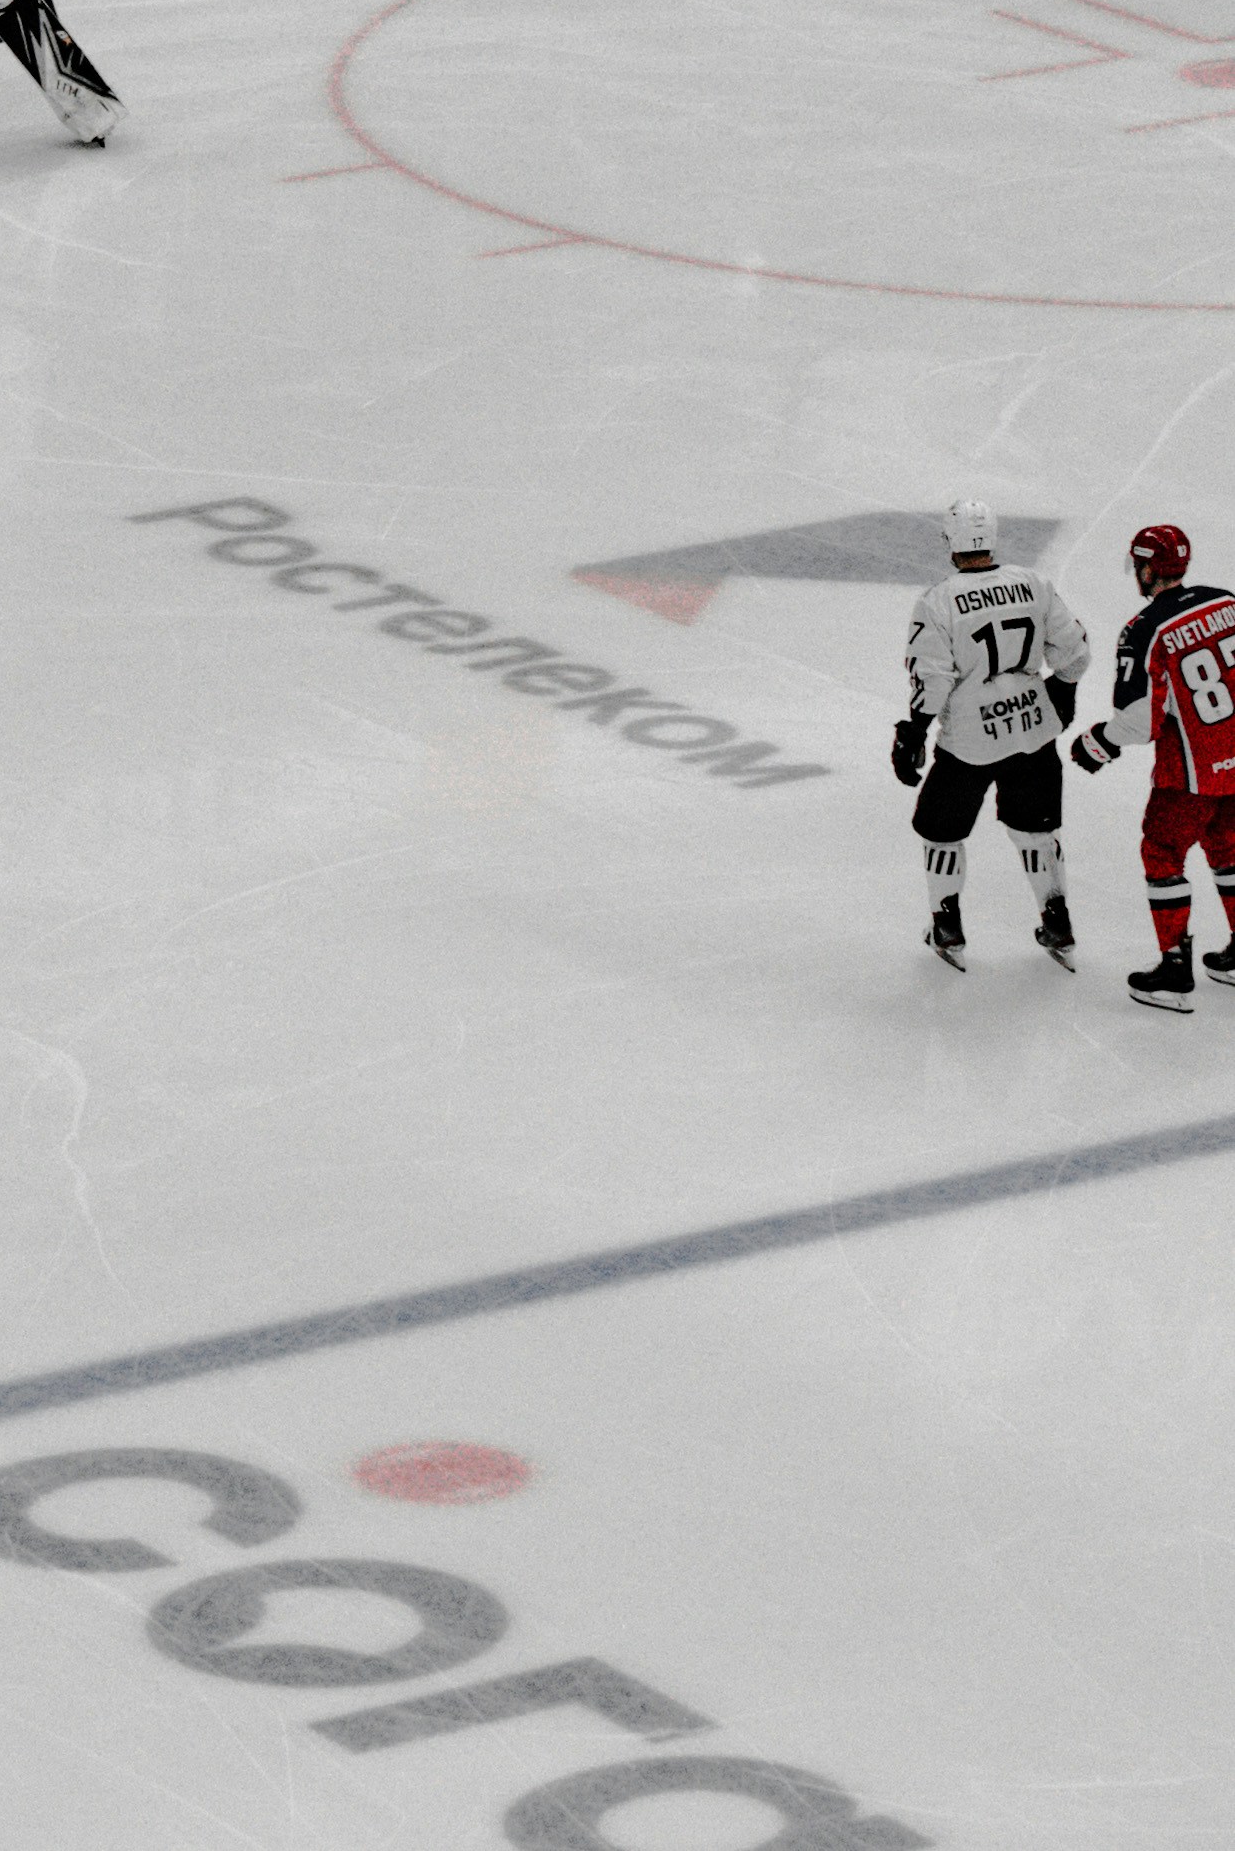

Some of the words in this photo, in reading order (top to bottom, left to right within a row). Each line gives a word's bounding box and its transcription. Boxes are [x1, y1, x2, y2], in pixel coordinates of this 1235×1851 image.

[972, 537, 984, 549] 17
[954, 583, 1034, 615] OSNOVIN
[971, 616, 1036, 684] 17
